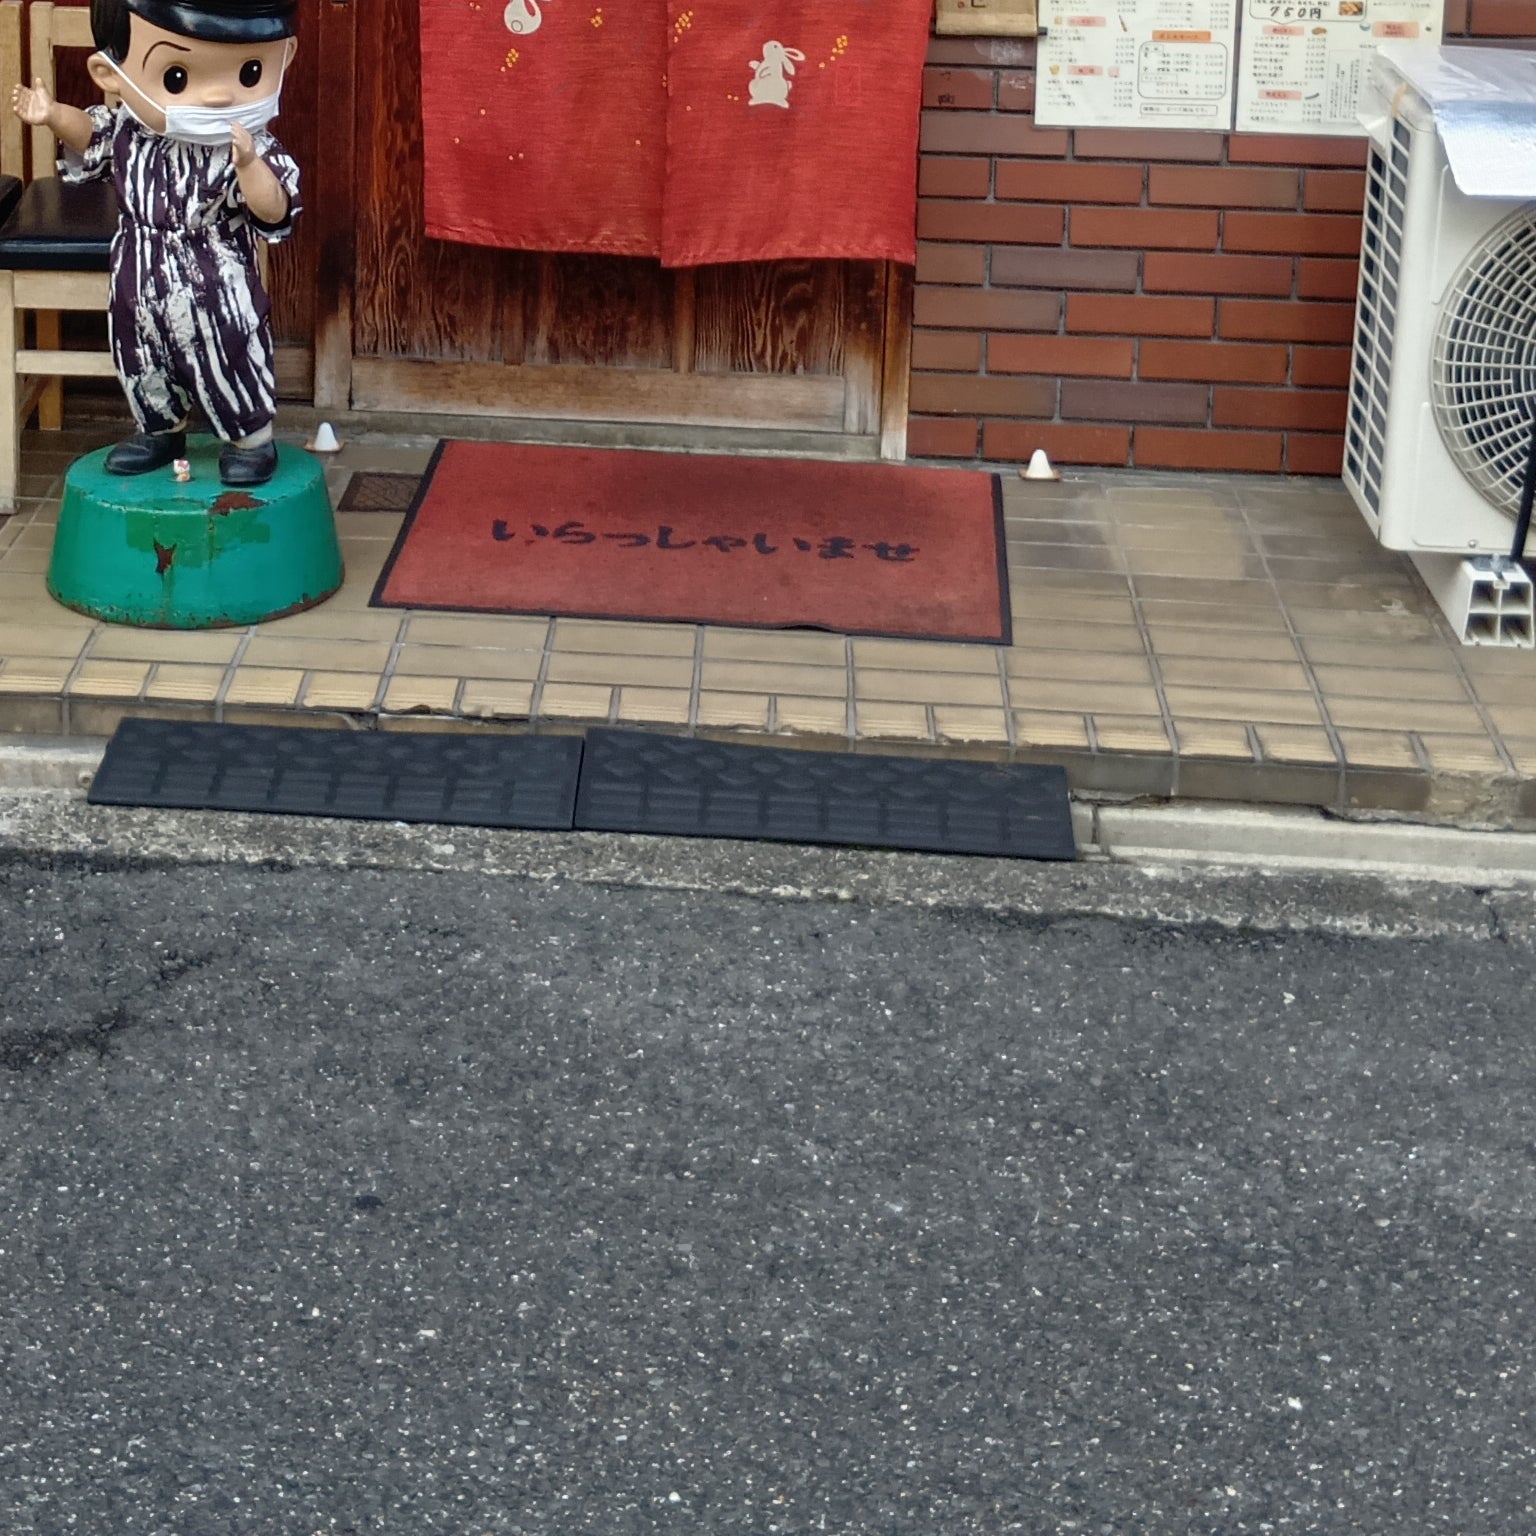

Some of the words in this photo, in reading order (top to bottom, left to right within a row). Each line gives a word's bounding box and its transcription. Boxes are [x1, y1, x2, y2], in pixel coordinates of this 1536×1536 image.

[491, 518, 921, 563] いらっしゃいませ
